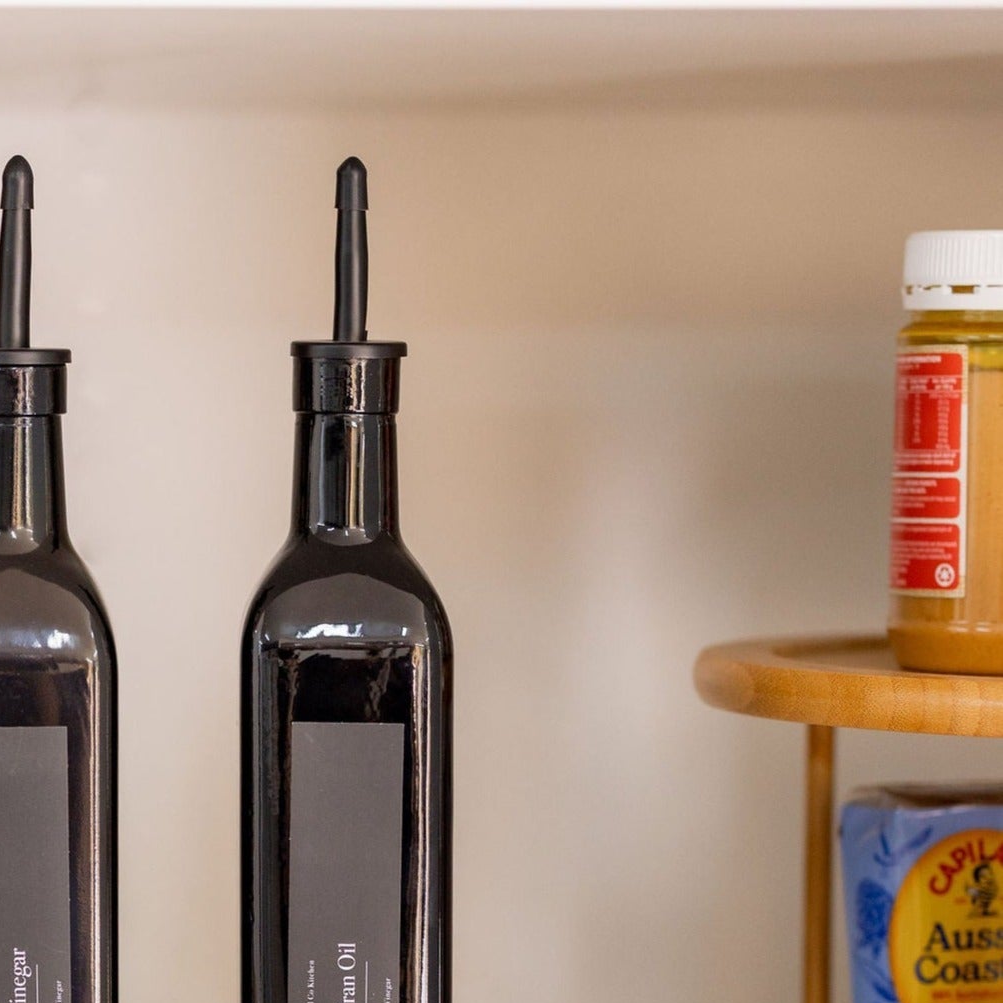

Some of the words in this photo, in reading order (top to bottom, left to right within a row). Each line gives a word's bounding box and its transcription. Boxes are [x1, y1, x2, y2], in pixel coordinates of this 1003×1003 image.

[337, 943, 356, 970] Oil
[307, 960, 315, 988] Kitchen
[307, 989, 315, 1000] Co
